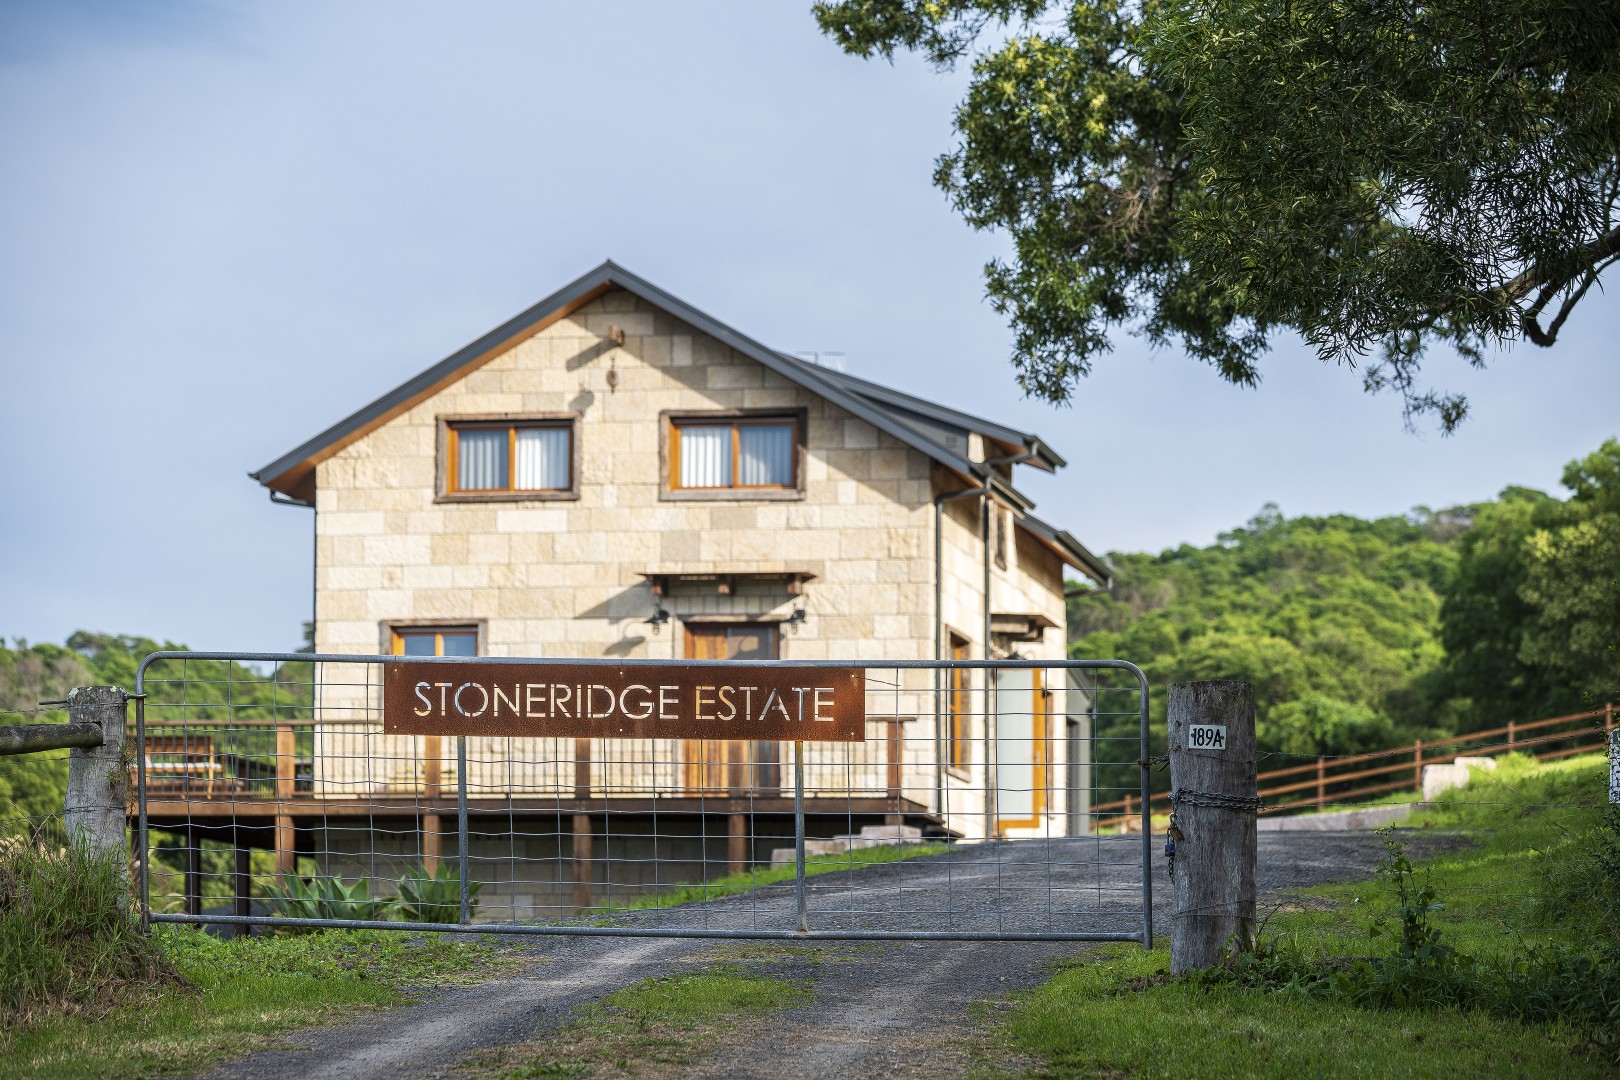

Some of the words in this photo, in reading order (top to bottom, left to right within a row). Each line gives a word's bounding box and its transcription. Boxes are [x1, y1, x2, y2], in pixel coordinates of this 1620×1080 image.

[414, 682, 679, 719] STONERIDGE
[695, 685, 835, 722] ESTATE
[1192, 727, 1223, 748] 189A
